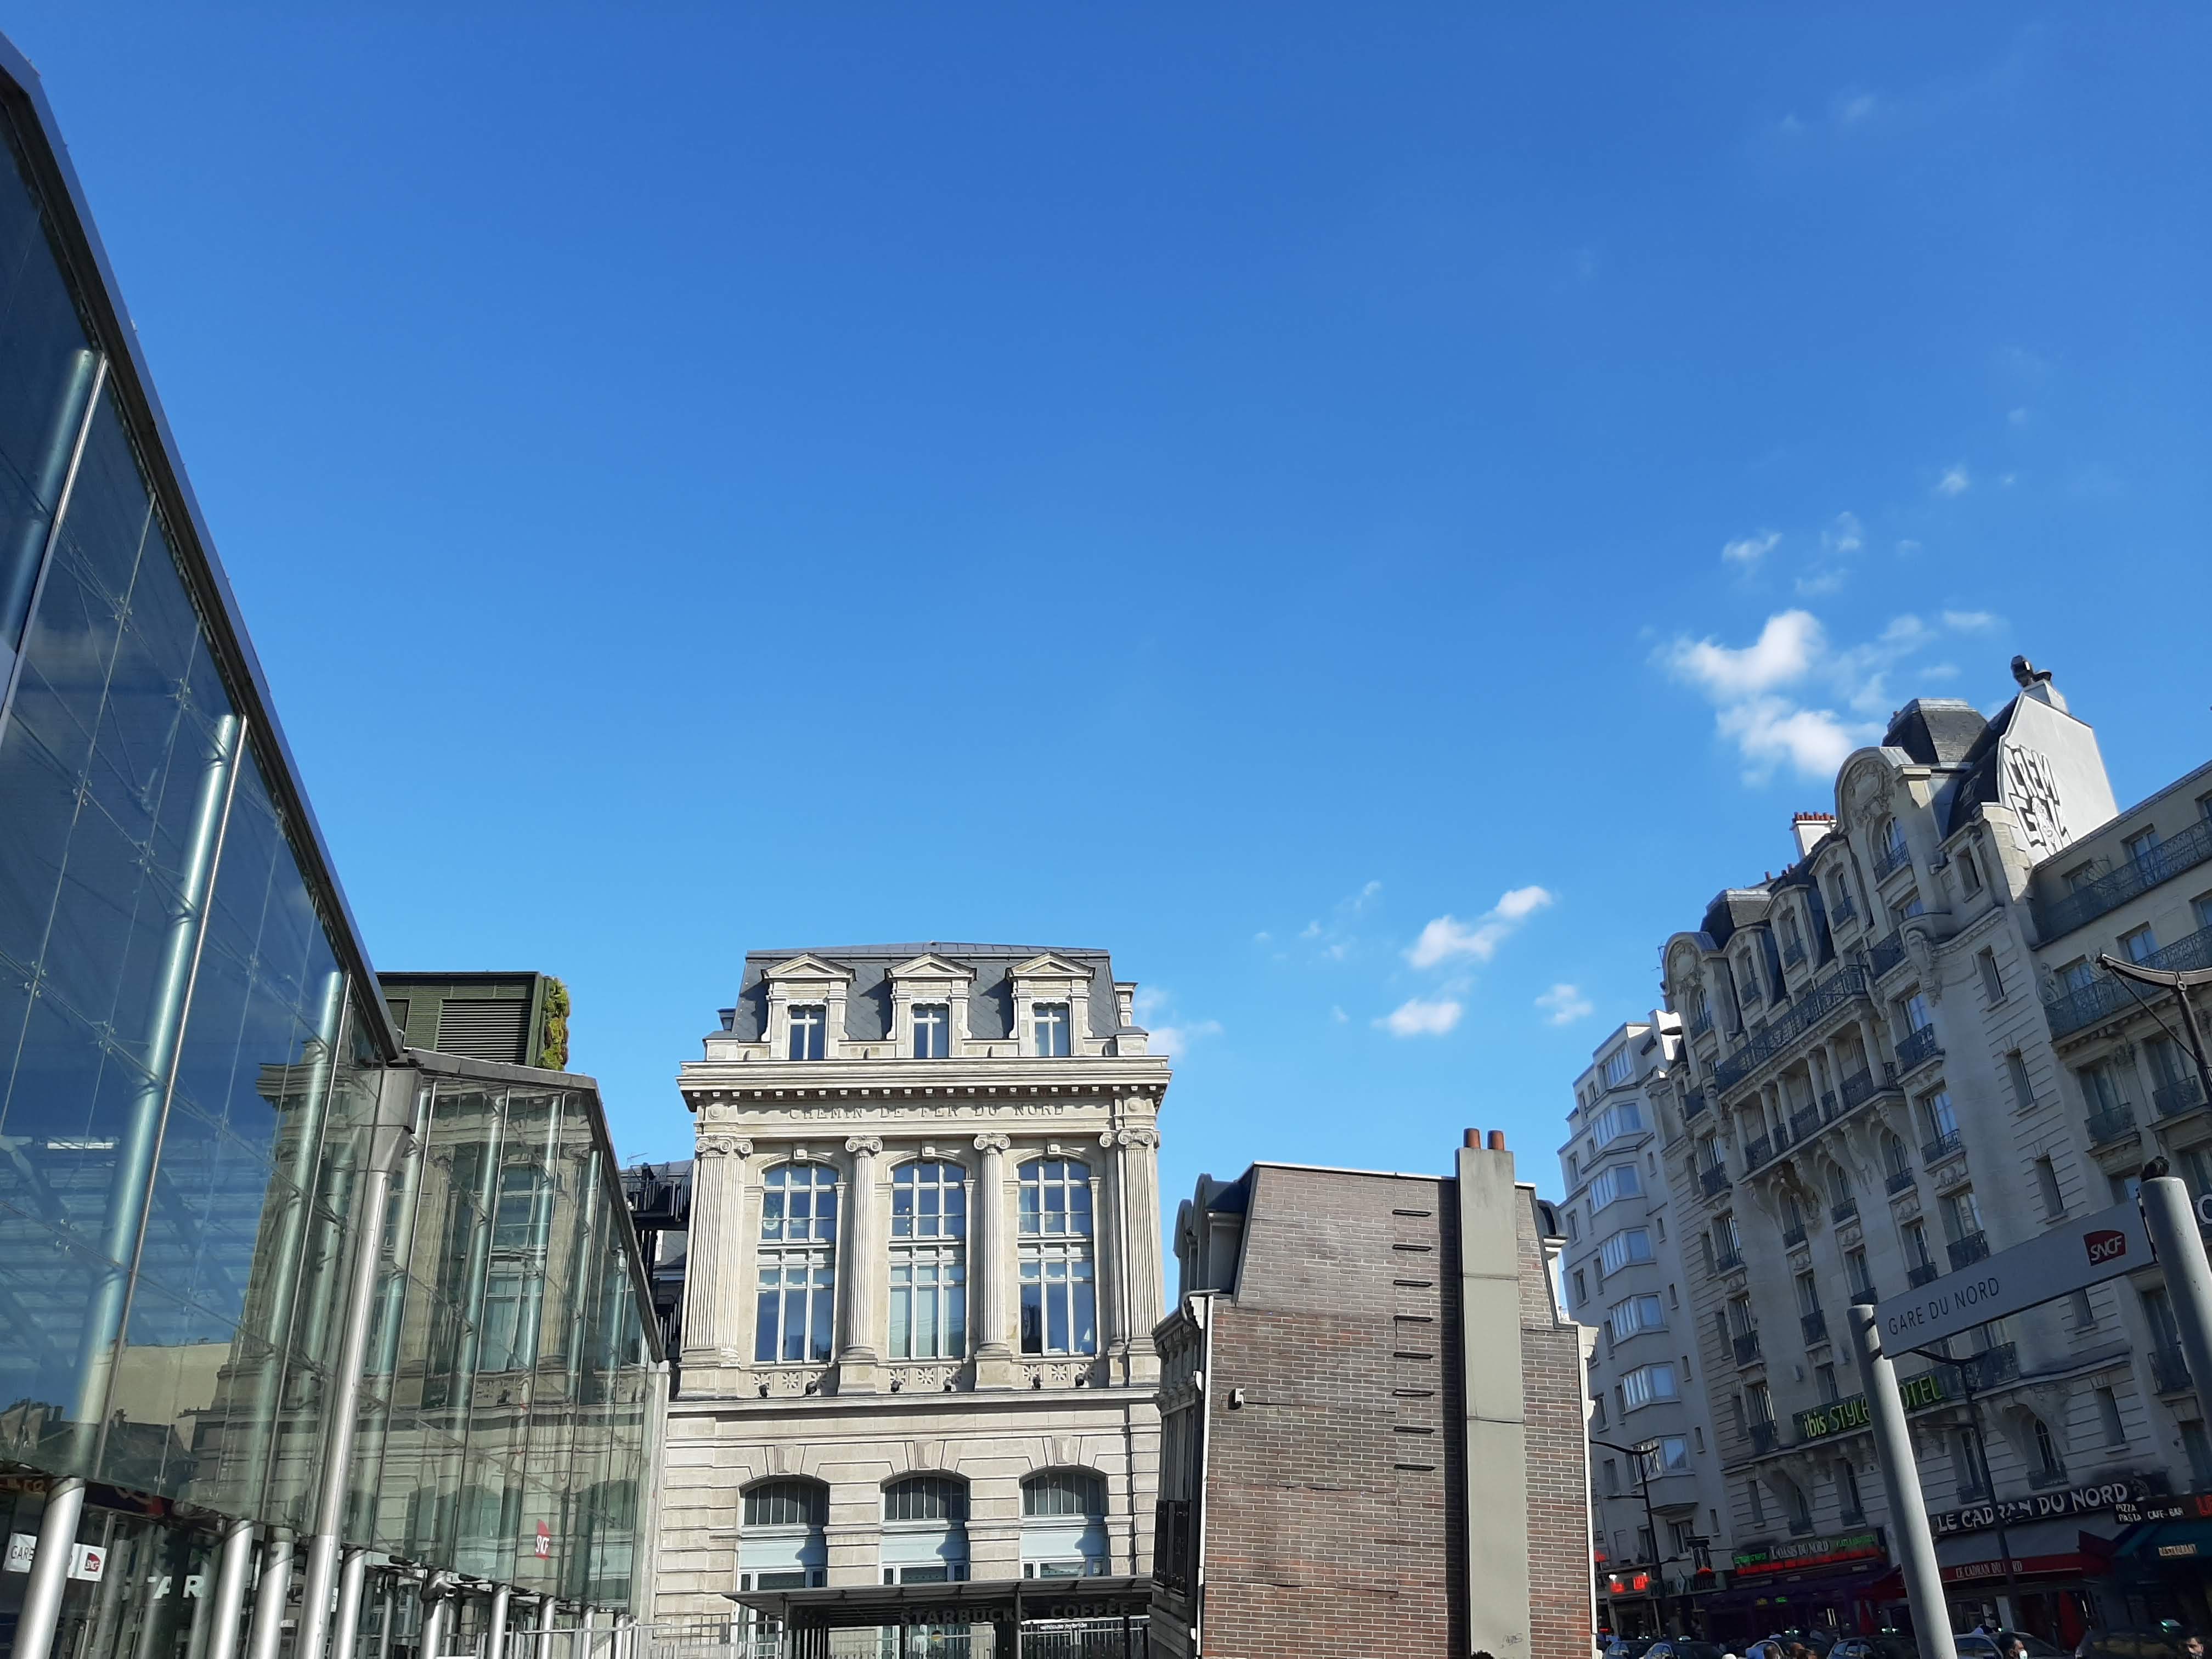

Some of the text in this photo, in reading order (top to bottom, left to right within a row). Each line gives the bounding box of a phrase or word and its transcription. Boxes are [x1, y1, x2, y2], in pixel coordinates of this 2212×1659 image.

[789, 1103, 1063, 1119] CHEMIN DE FER DU NORD
[2090, 1235, 2122, 1261] SNCF
[1888, 1277, 2000, 1335] GARE DU NORD
[1803, 1412, 1827, 1438] ibis
[1899, 1375, 1942, 1410] OTEL
[1937, 1514, 1957, 1532] LE
[2036, 1494, 2066, 1515] DU
[2070, 1483, 2128, 1511] NORD
[2115, 1503, 2137, 1512] PIZZA
[1955, 1567, 1964, 1579] LE
[1965, 1562, 1990, 1577] CADRAN
[1990, 1562, 2001, 1573] DU
[900, 1602, 1130, 1626] STARBUCKS COFFEE
